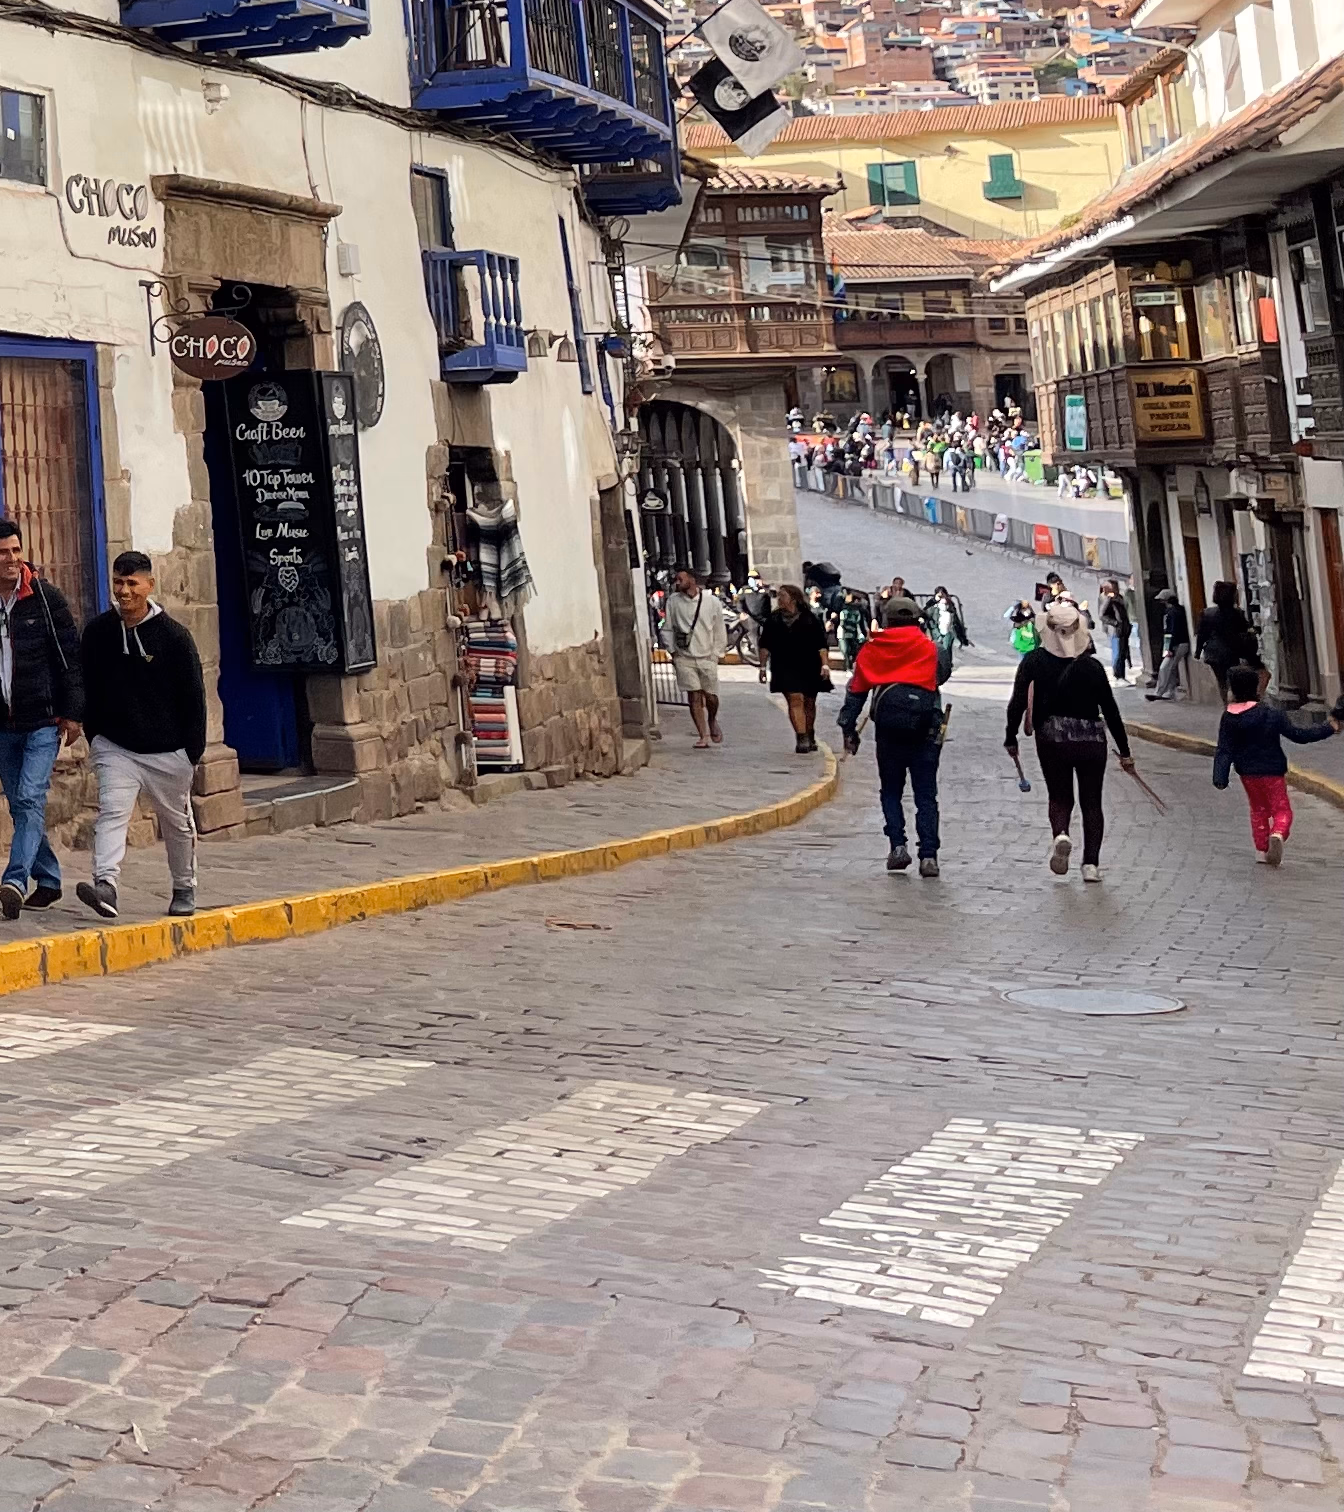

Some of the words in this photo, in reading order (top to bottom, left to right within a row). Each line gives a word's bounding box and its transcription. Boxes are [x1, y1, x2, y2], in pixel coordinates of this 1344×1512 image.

[66, 173, 149, 221] CHOCO
[172, 334, 251, 360] CHOCO
[235, 423, 271, 444] Craft
[270, 421, 306, 440] Beer
[242, 469, 261, 486] 10
[269, 546, 303, 567] Sports
